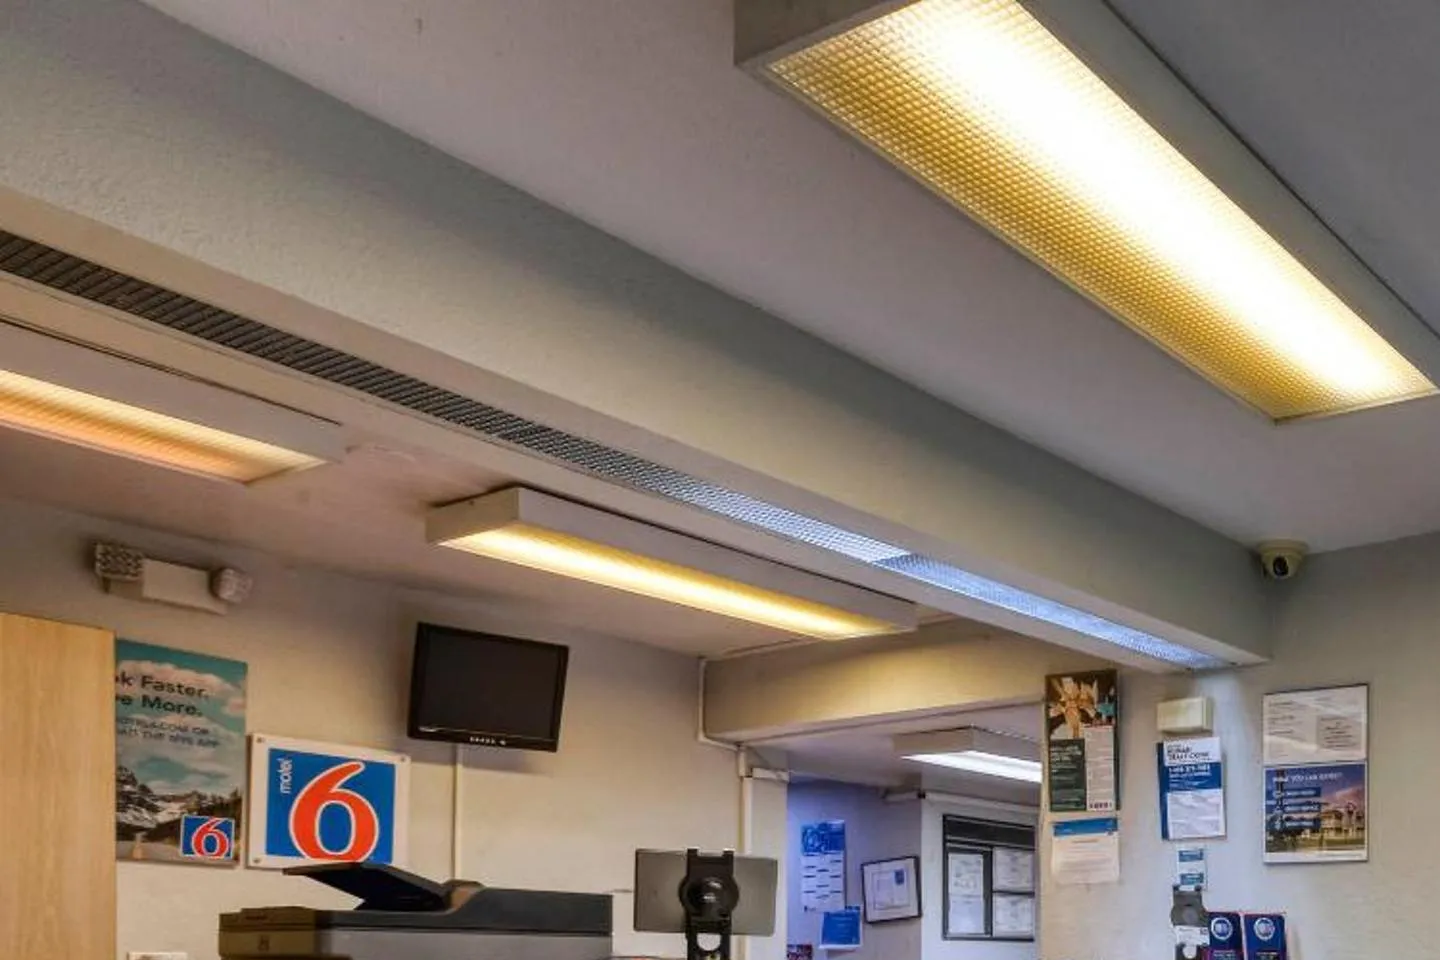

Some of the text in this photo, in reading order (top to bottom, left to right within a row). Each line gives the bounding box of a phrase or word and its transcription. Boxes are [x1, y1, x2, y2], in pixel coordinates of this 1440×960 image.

[141, 674, 209, 700] Faster.
[141, 694, 203, 717] More.
[276, 757, 293, 794] motel
[289, 761, 379, 862] 6
[191, 817, 230, 860] 6
